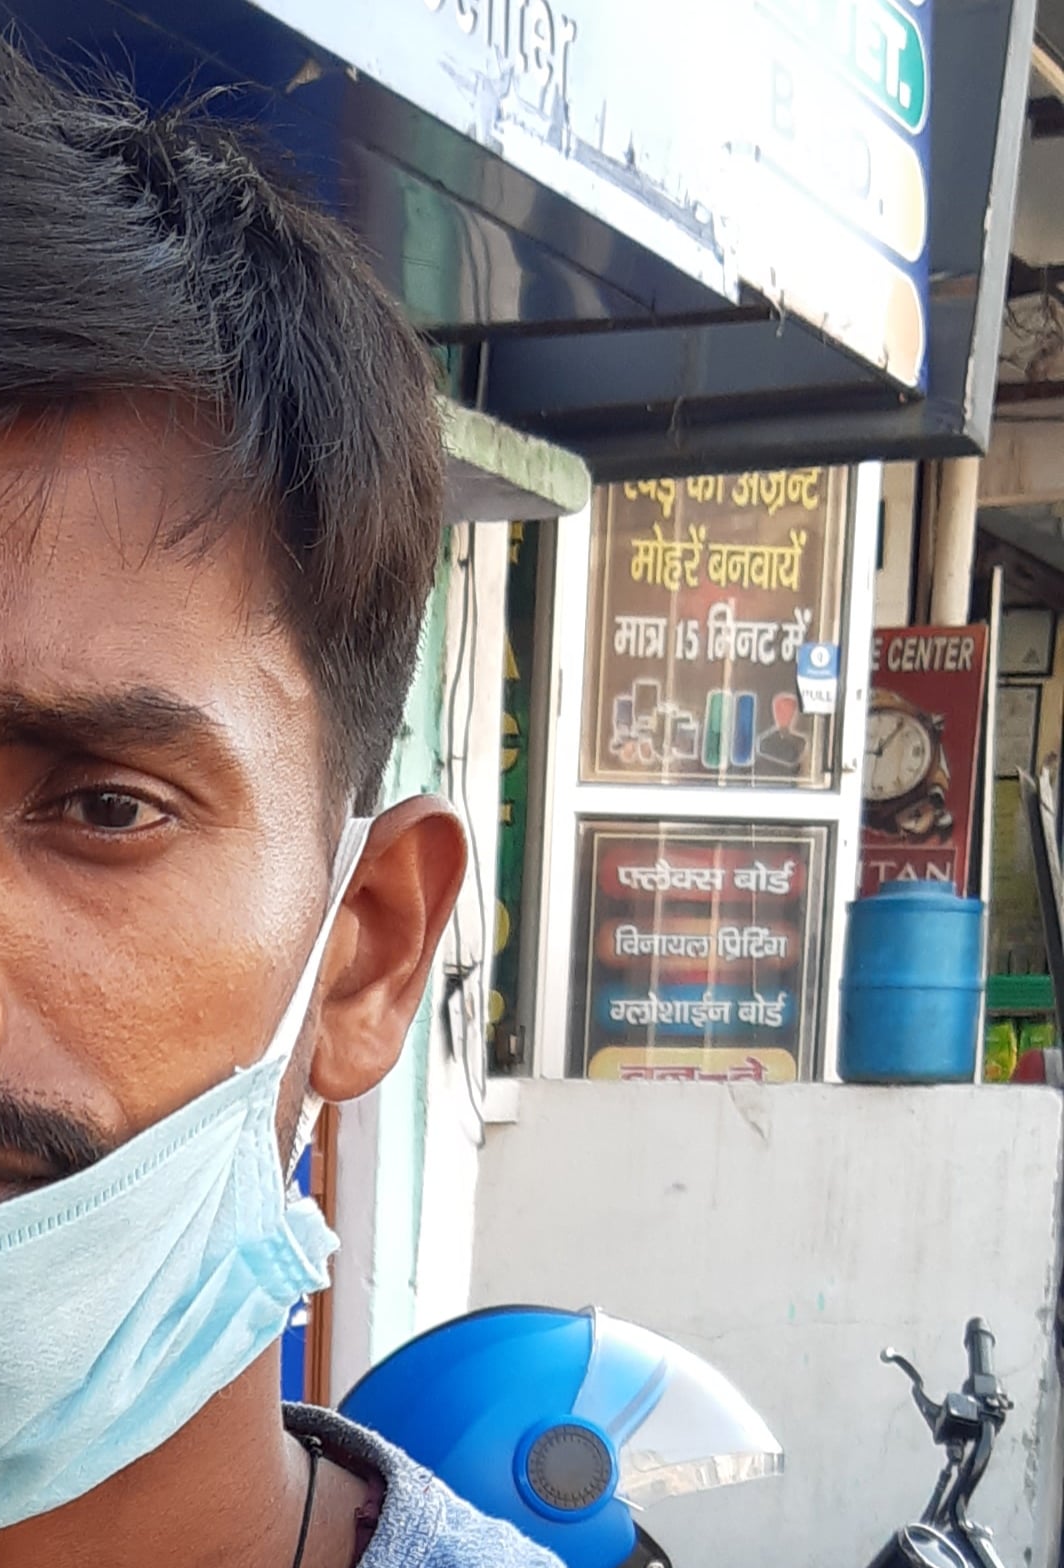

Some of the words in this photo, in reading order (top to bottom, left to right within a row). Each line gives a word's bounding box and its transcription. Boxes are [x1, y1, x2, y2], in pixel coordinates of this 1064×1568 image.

[631, 522, 706, 591] मोहरें
[708, 528, 807, 592] बनवायें
[614, 615, 667, 659] मात्र
[675, 618, 699, 661] 15
[707, 602, 779, 665] मिनट
[887, 635, 975, 672] CENTER
[734, 860, 796, 895] बोर्ड
[737, 990, 788, 1028] बोर्ड
